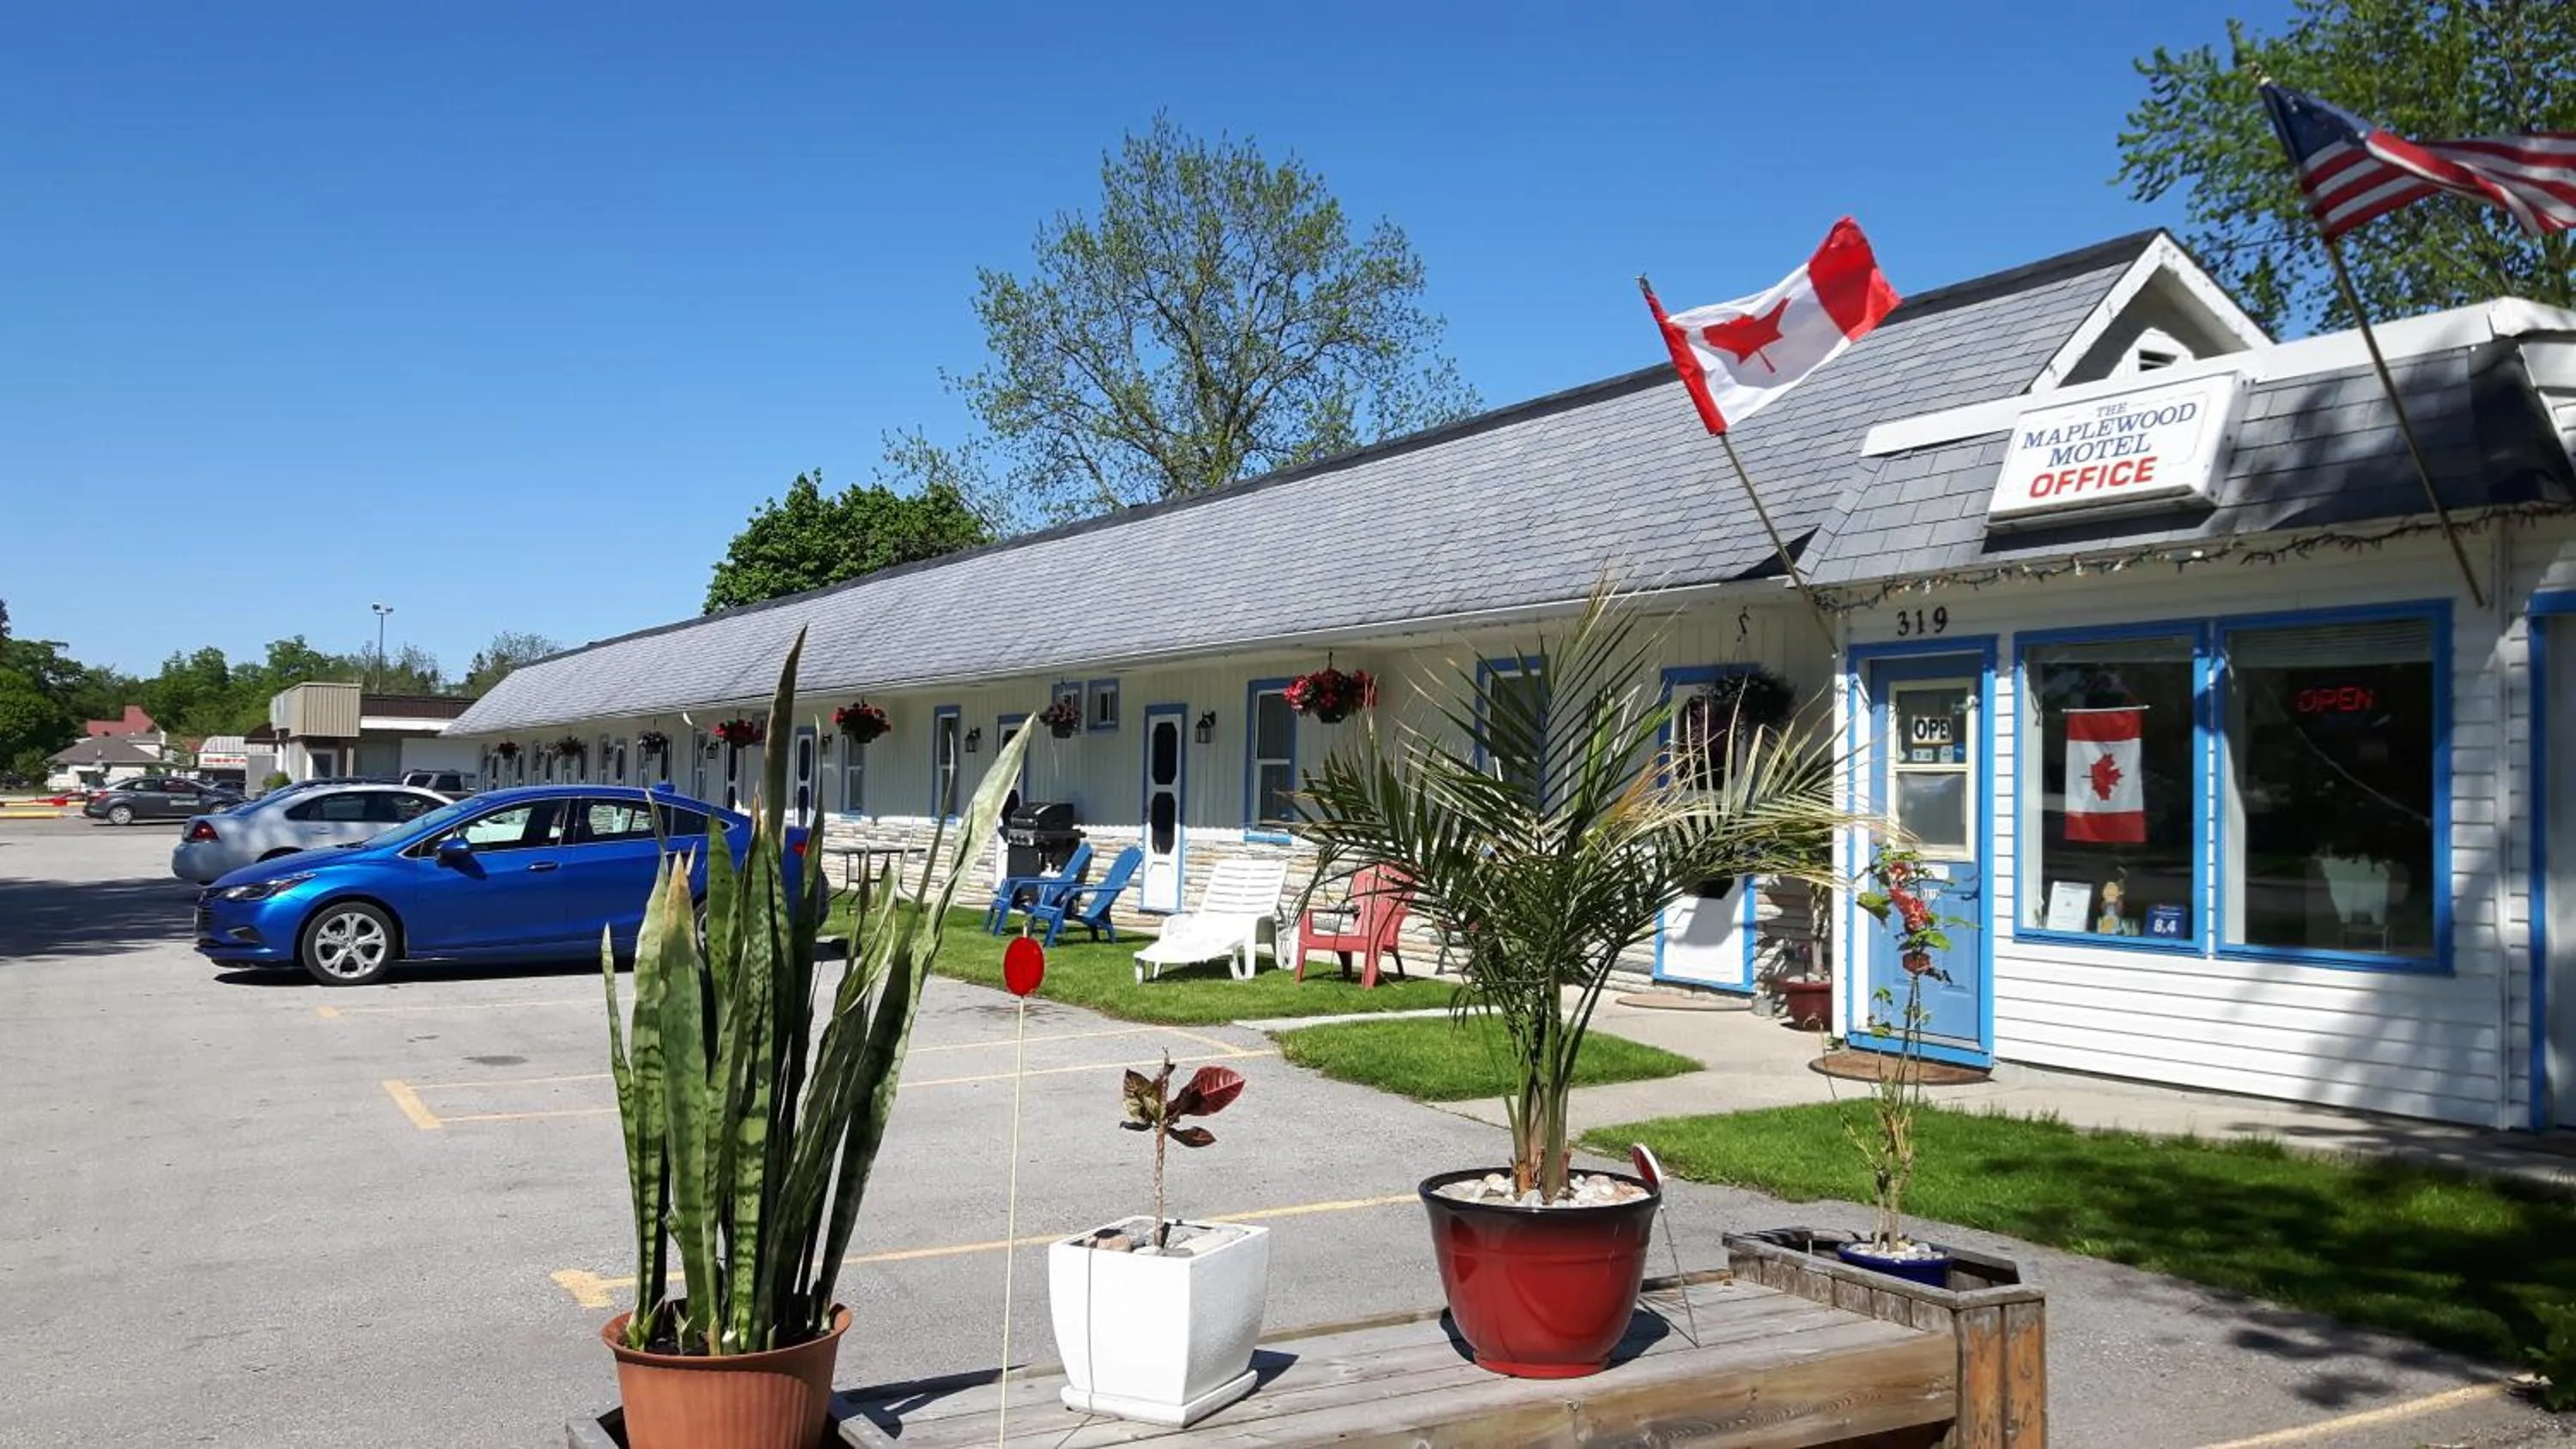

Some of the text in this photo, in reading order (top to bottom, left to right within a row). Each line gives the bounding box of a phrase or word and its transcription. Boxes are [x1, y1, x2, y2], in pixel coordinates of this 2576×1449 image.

[2097, 402, 2128, 418] THE
[2021, 403, 2196, 450] MAPLEWOOD
[2047, 433, 2152, 468] MOTEL
[2029, 456, 2158, 498] OFFICE
[1897, 606, 1949, 636] 319
[2298, 686, 2375, 712] OPEN
